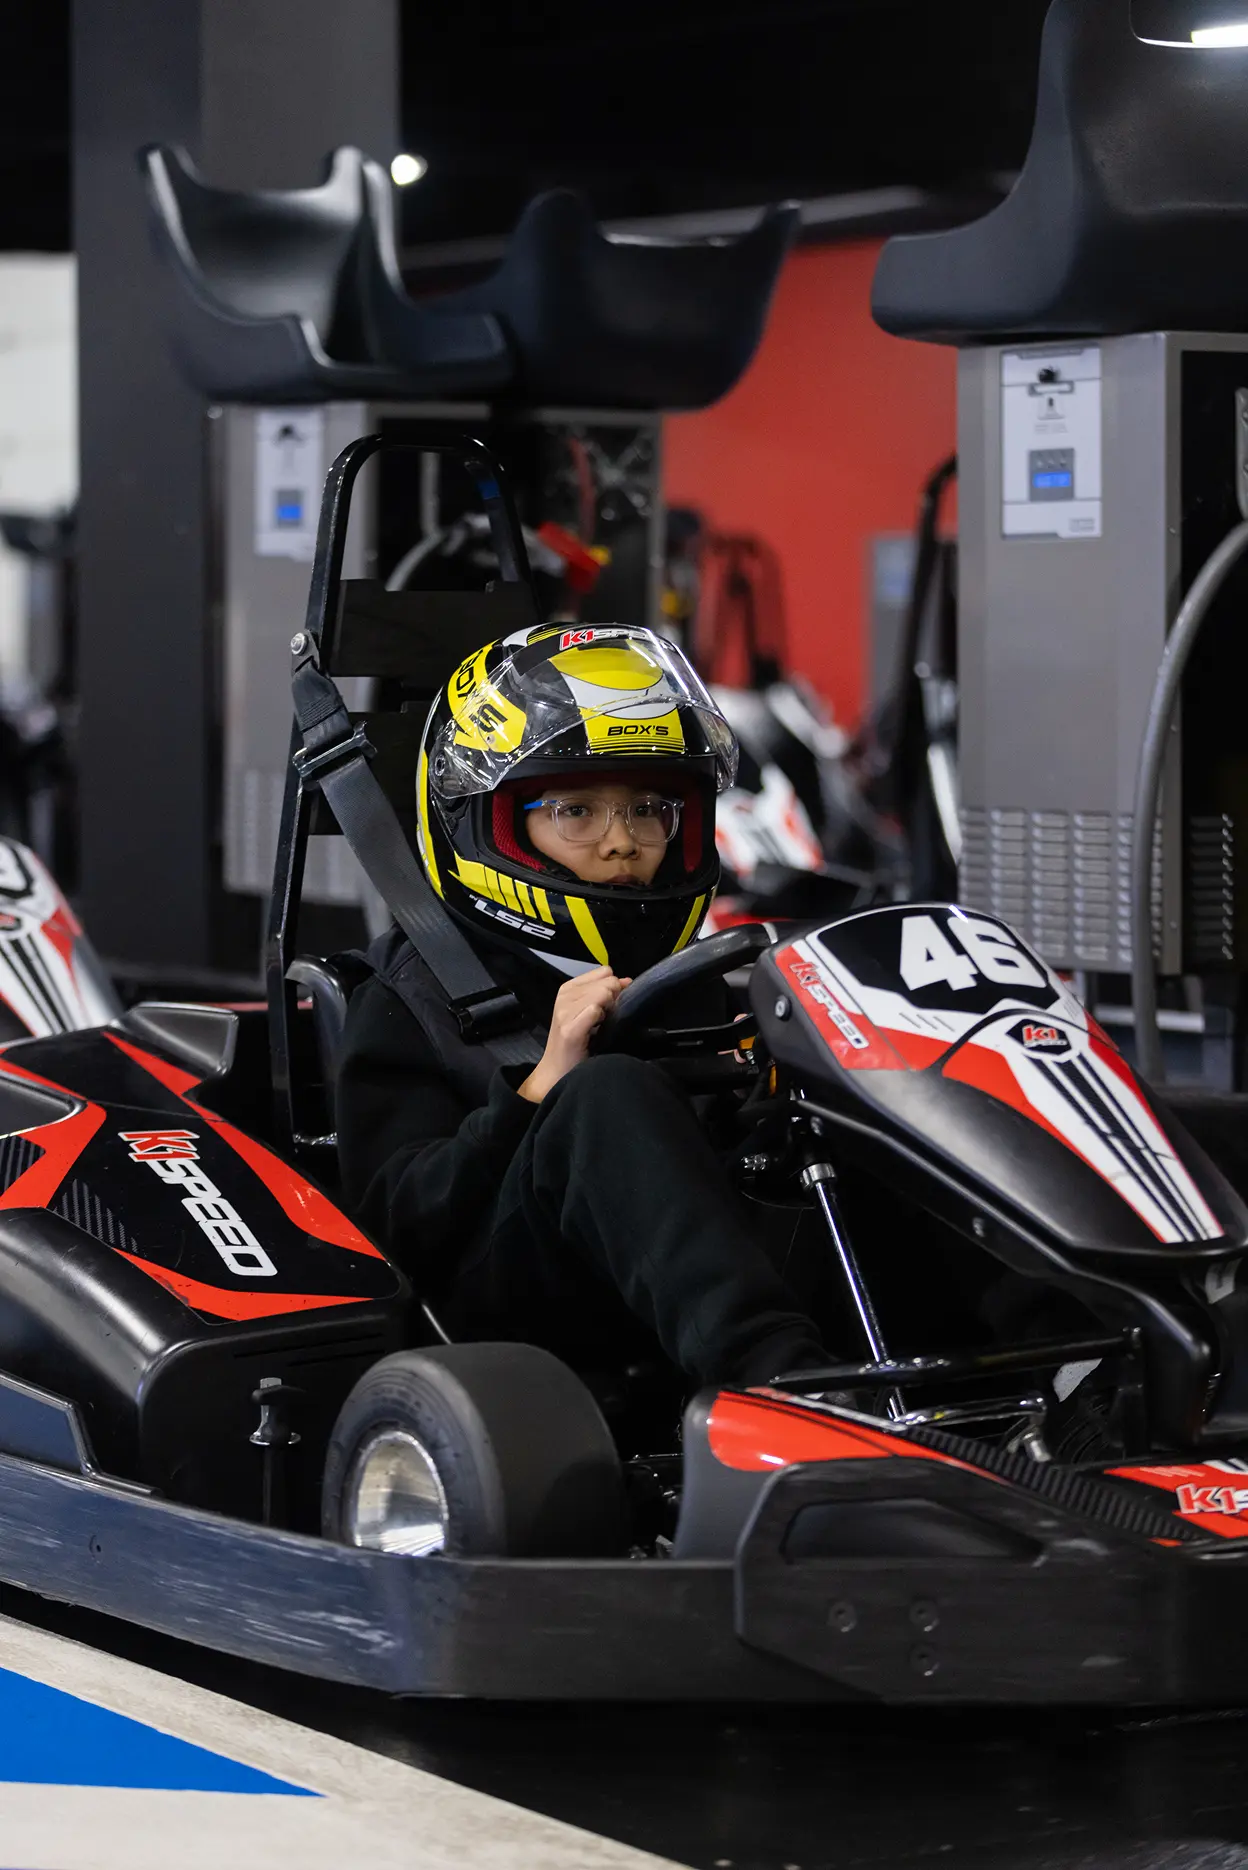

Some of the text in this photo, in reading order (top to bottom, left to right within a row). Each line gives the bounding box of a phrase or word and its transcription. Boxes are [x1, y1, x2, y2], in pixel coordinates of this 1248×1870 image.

[607, 724, 669, 737] BOX'S
[474, 899, 556, 941] LS2
[899, 914, 1049, 992] 46
[1022, 1024, 1060, 1044] K1
